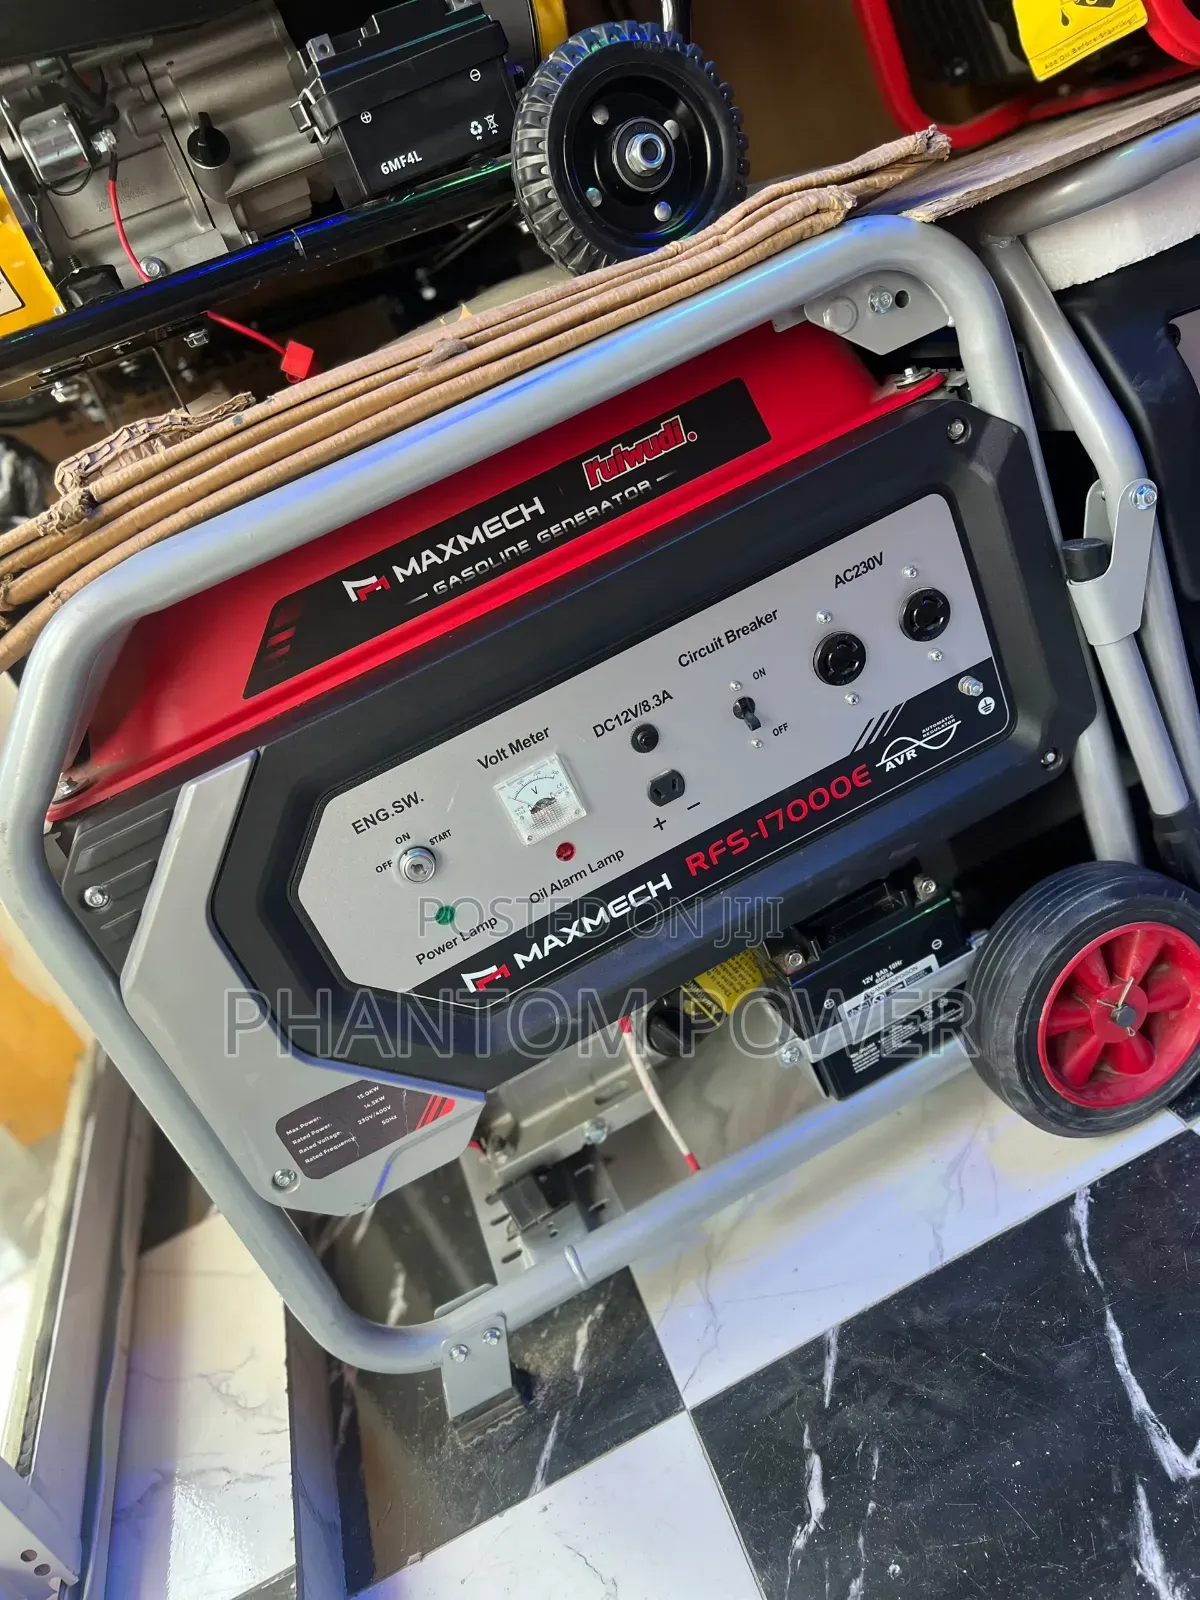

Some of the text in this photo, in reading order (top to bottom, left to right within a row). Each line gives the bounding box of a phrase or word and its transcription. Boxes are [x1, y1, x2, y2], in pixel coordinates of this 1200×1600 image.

[380, 150, 423, 175] 6MF4L
[392, 496, 545, 584] MAXMECH
[433, 479, 652, 596] GASOLINE GENERATOR
[834, 552, 884, 589] AC230V
[678, 608, 778, 668] Circuit Breaker
[752, 667, 767, 680] ON
[592, 689, 674, 738] DC12V/8.3A
[772, 722, 789, 737] OFF
[922, 714, 955, 734] AUTOMATIC
[922, 718, 956, 738] REGULATOR
[476, 727, 550, 769] Volt Meter
[885, 749, 918, 772] AVR
[351, 791, 425, 835] ENG.SW.
[395, 832, 411, 845] ON
[429, 829, 453, 846] START
[375, 860, 394, 874] OFF
[513, 763, 872, 971] MAXMECH RFS-17000E
[528, 849, 626, 905] Oil Alarm Lamp
[415, 915, 498, 966] Power Lamp
[862, 975, 874, 985] 12V
[357, 1085, 379, 1099] 15.0KW
[292, 1133, 311, 1145] Rated
[364, 1095, 385, 1109] 14.5KW
[299, 1143, 317, 1155] Rated
[357, 1105, 391, 1125] 230V/400V
[305, 1152, 323, 1164] Rated
[381, 1115, 397, 1126] 50Hz
